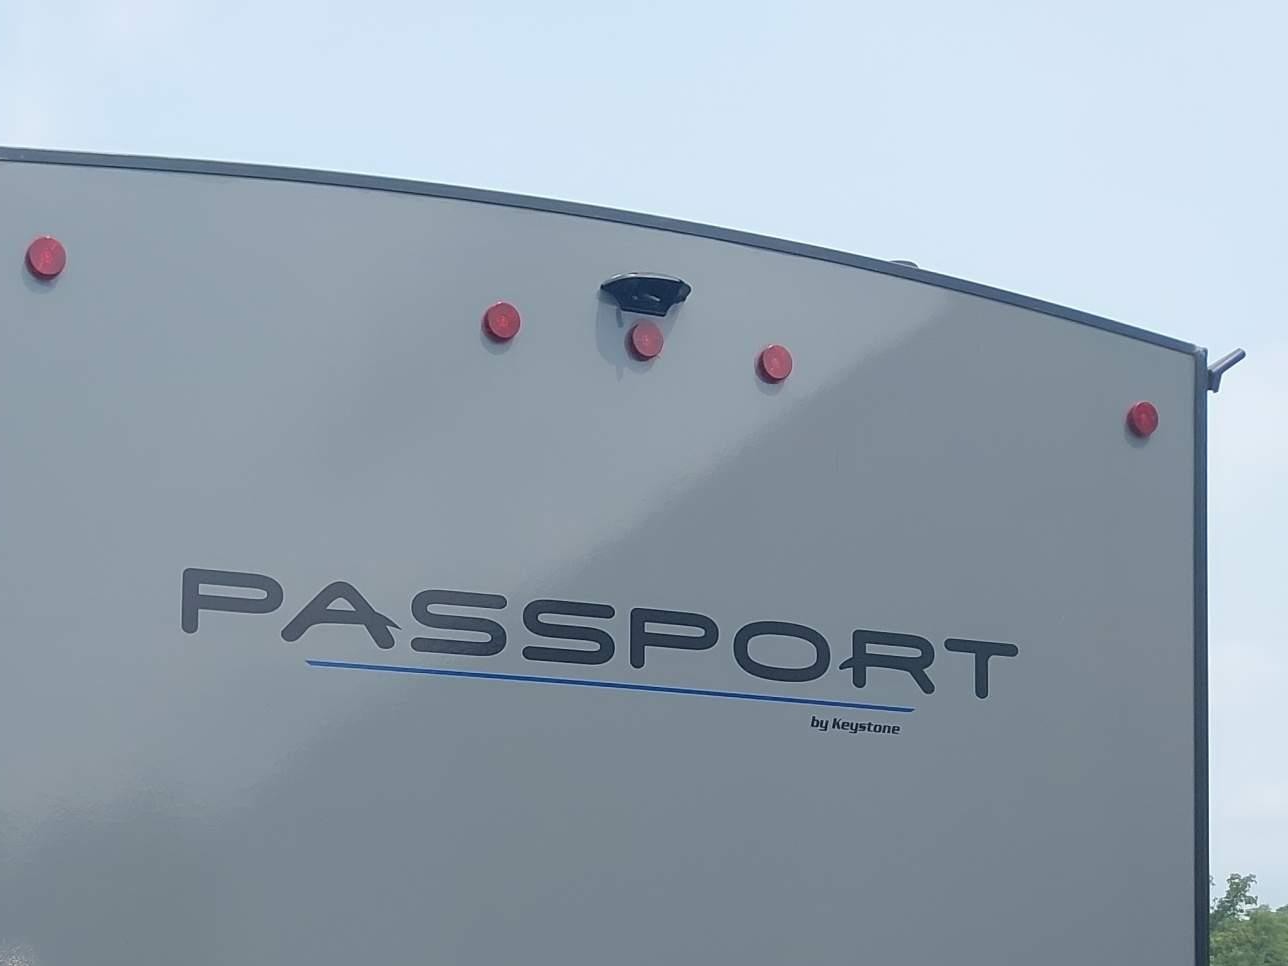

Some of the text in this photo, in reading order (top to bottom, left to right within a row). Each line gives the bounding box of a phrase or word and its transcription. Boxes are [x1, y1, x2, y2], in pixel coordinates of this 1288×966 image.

[181, 566, 1019, 700] PASSPORT
[810, 715, 901, 735] by Keystone
